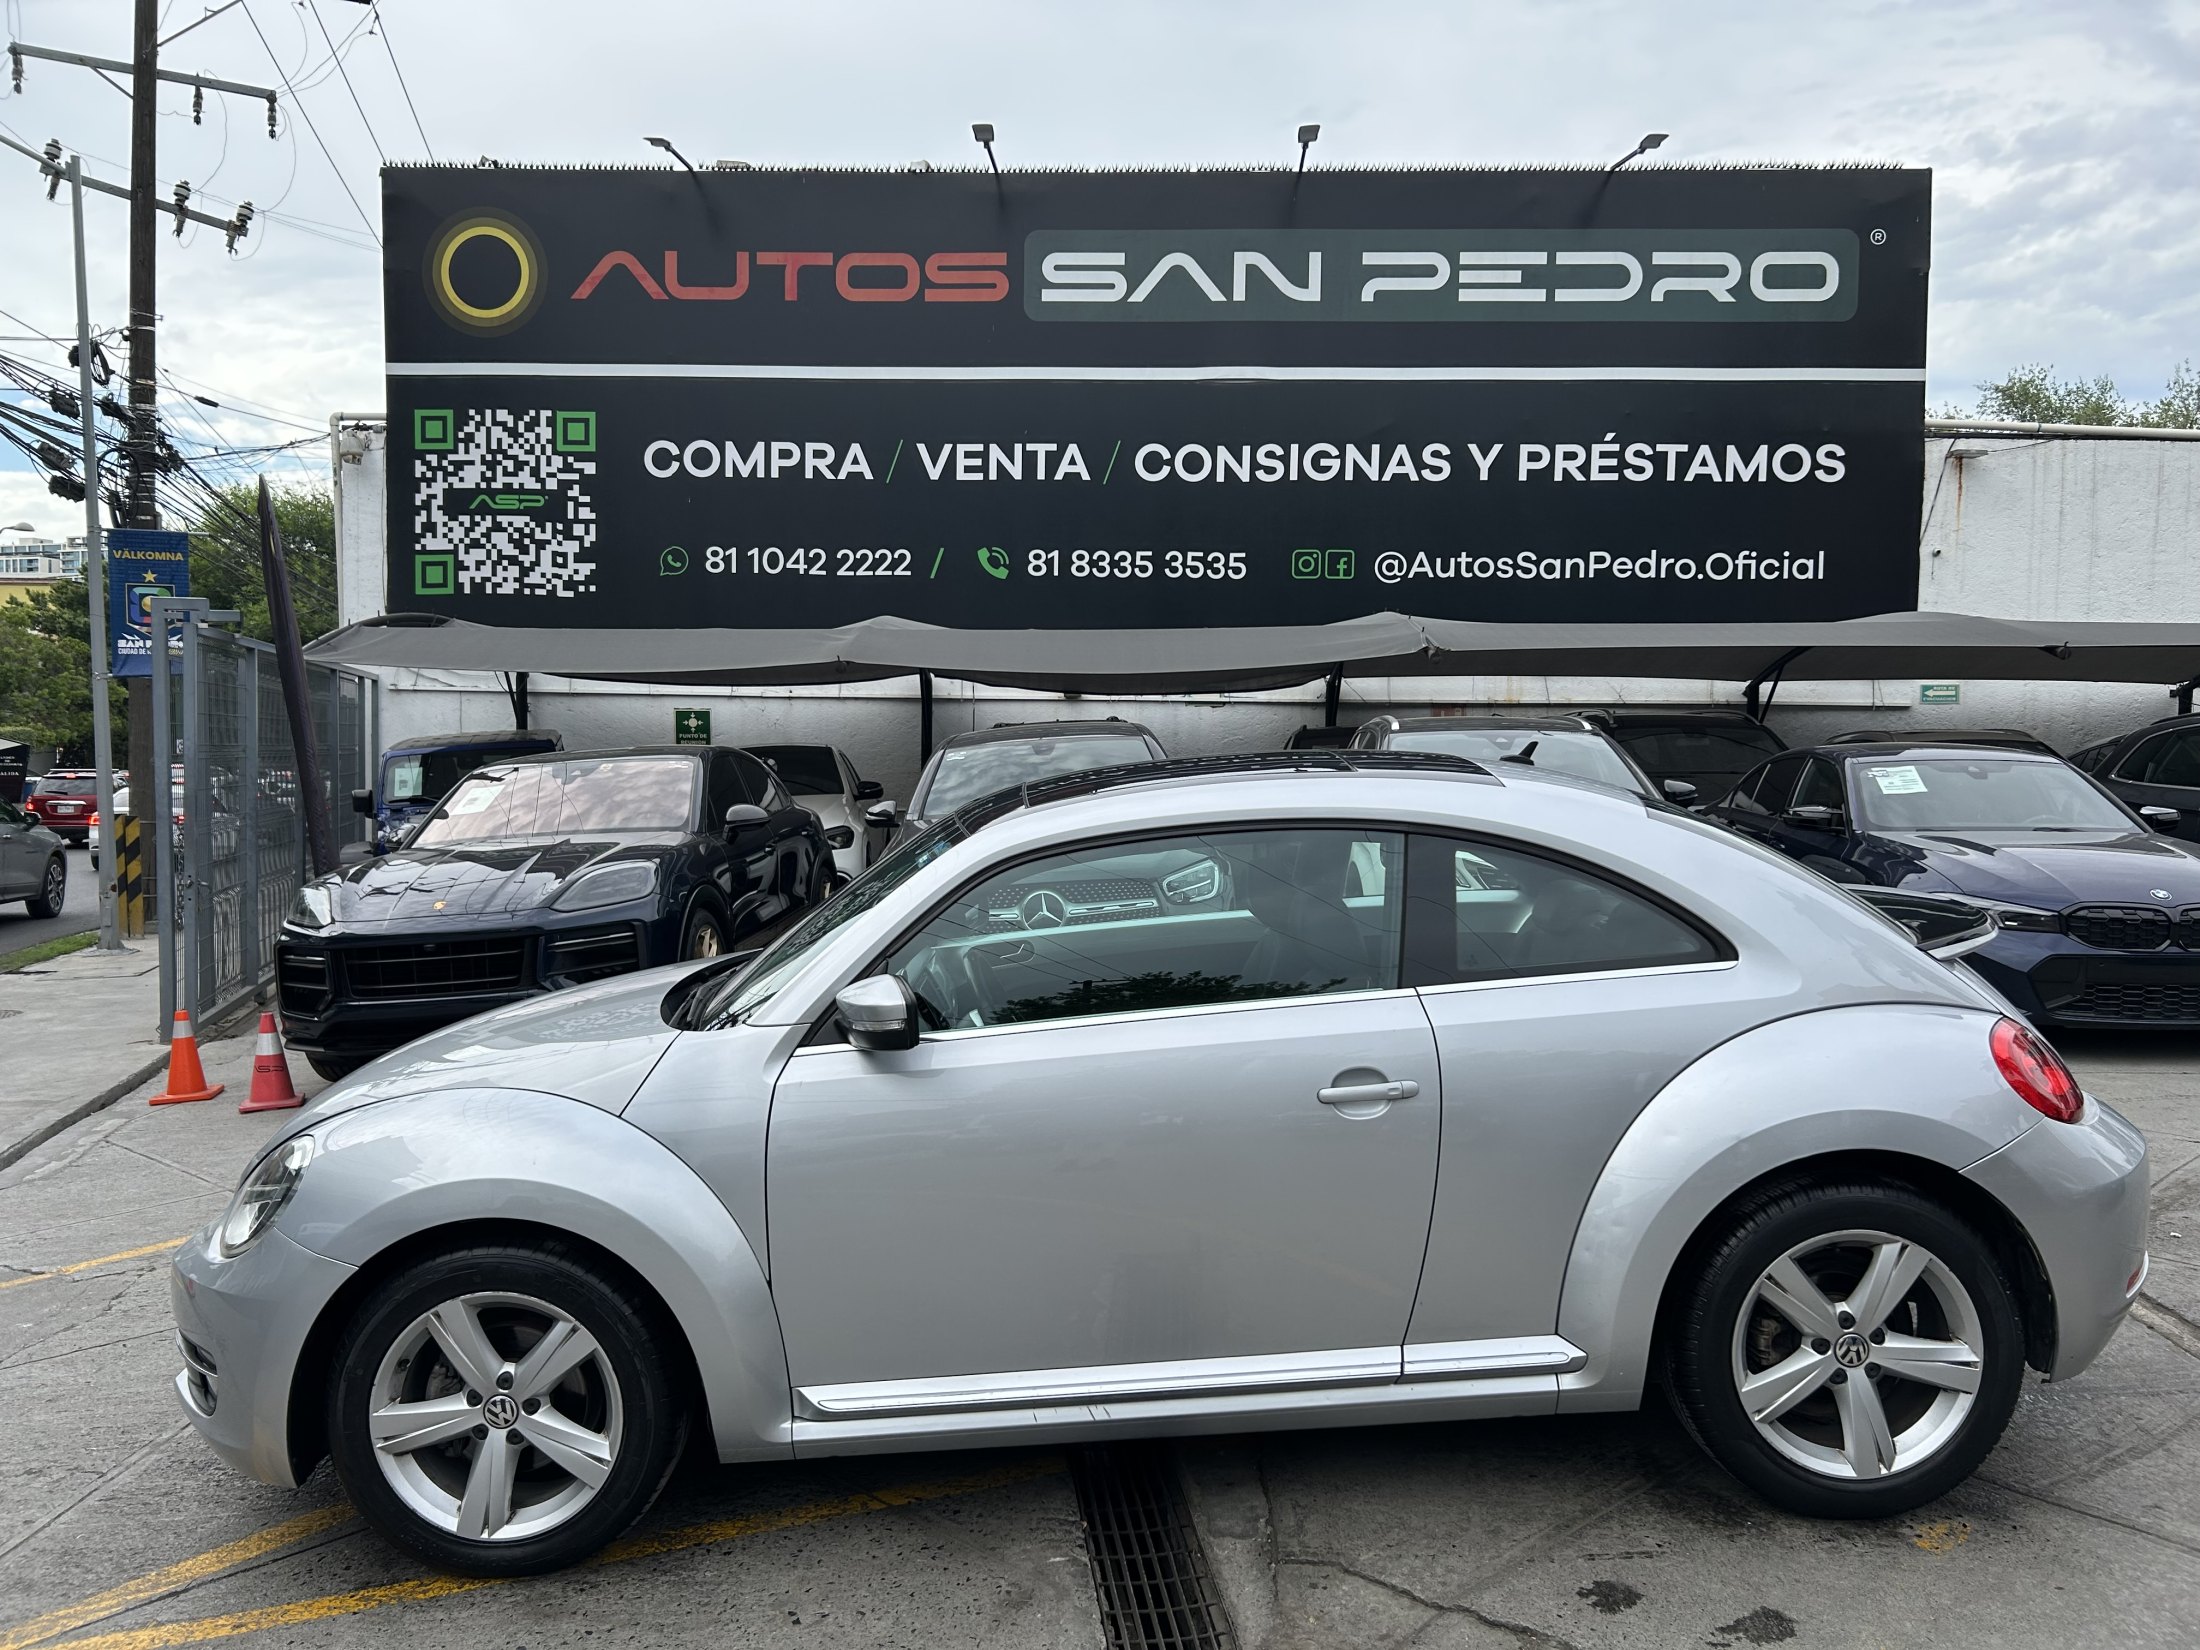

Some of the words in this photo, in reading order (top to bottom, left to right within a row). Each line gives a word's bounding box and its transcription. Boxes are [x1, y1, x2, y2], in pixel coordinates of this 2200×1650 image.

[571, 251, 1010, 302] AUTOS
[1041, 251, 1322, 303] SAN
[1360, 251, 1840, 303] PEDRO
[643, 439, 875, 481] COMPRA
[915, 442, 1092, 482] VENTA
[1134, 442, 1452, 483] CONSIGNAS
[1466, 443, 1505, 482] Y
[1518, 432, 1846, 483] PRÉSTAMOS
[113, 548, 184, 560] VÄLKOMNA
[705, 545, 737, 574] 81
[747, 546, 828, 576] 1042
[836, 548, 912, 577] 2222
[1027, 548, 1060, 577] 81
[1070, 549, 1154, 579] 8335
[1164, 550, 1247, 580] 3535
[1374, 549, 1825, 584] @AutosSanPedro.Oficial
